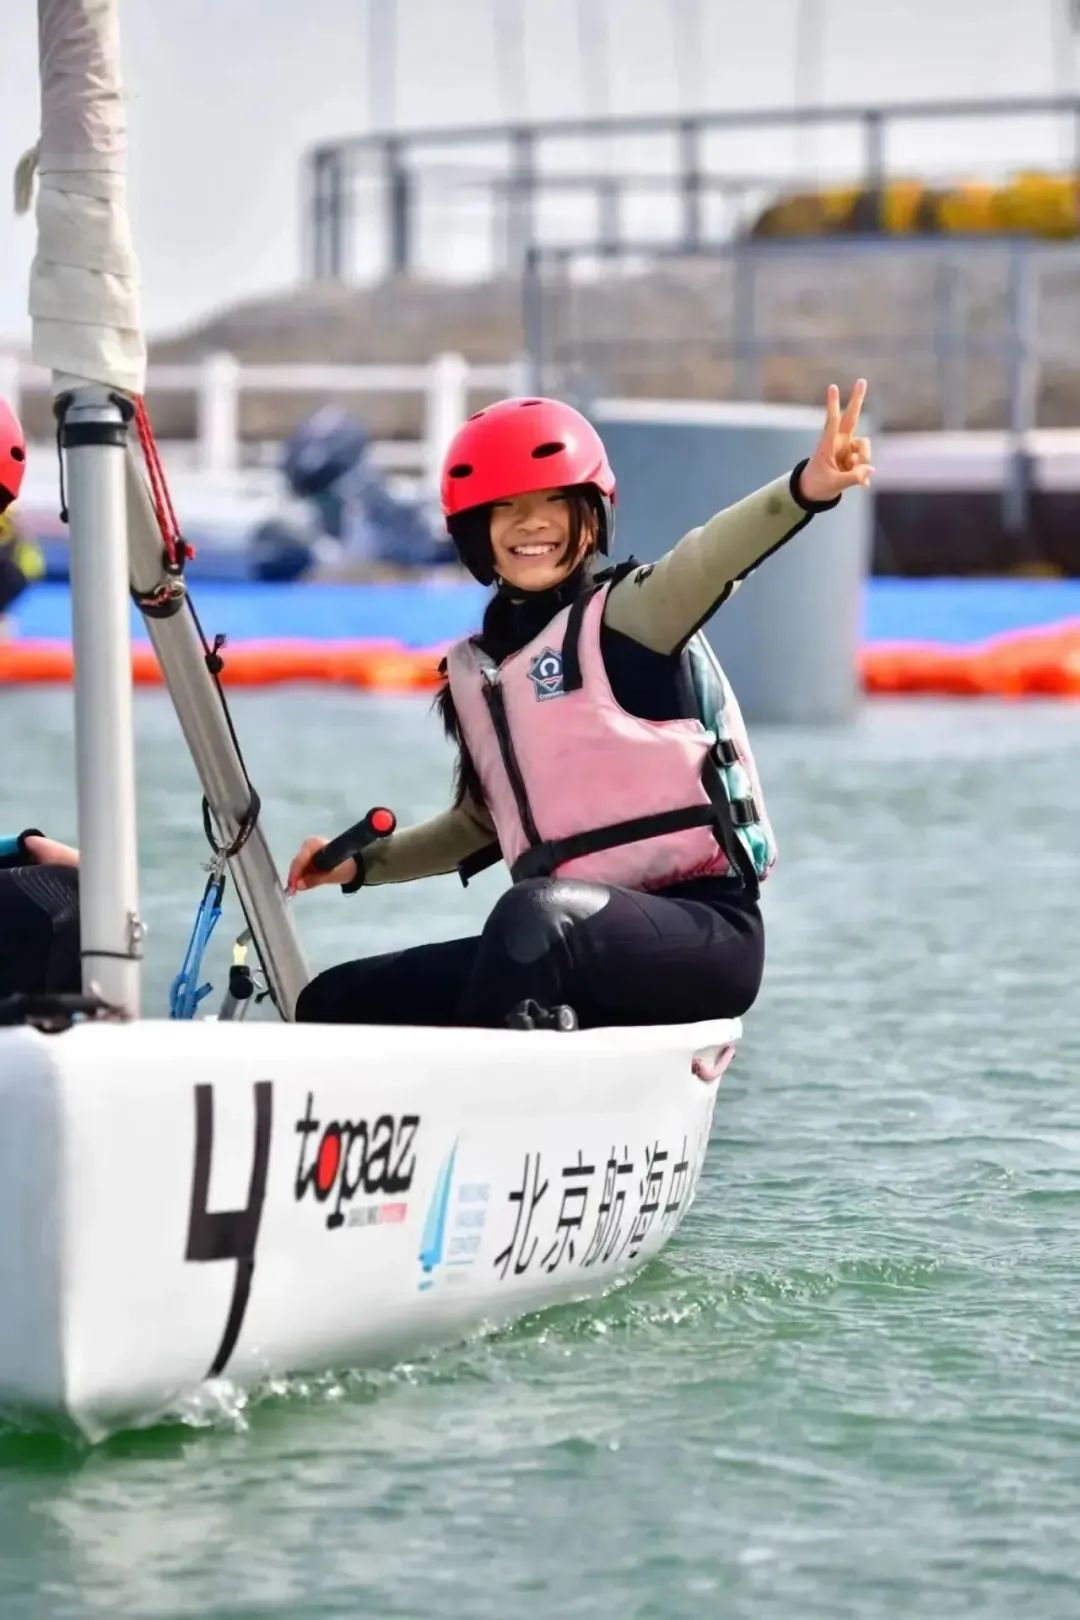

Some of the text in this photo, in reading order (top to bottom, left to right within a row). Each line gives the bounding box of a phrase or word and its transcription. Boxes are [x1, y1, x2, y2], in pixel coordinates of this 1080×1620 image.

[185, 1081, 273, 1379] 4
[294, 1091, 421, 1230] topaz
[493, 1133, 702, 1280] 北京航海中
